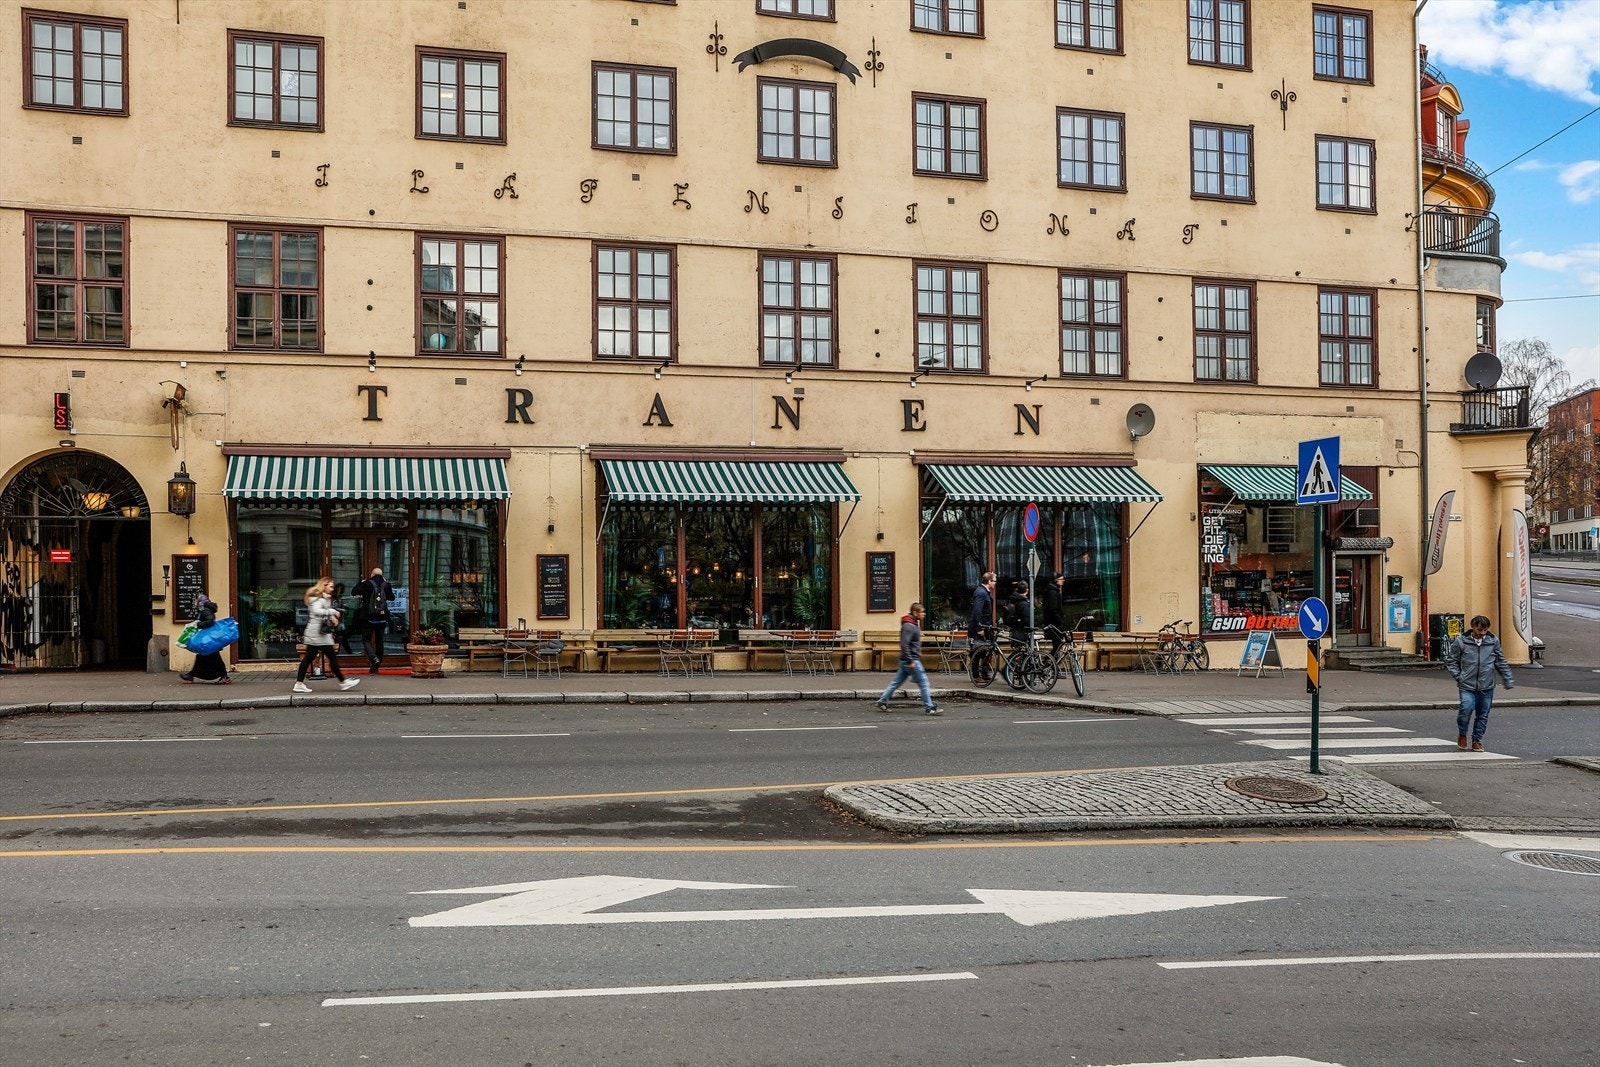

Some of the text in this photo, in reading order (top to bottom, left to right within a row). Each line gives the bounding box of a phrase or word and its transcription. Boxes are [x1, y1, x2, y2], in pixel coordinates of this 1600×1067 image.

[358, 384, 1044, 436] TRANEN
[1202, 517, 1226, 526] GET
[1203, 526, 1220, 535] FIT
[1205, 536, 1224, 545] DIE
[1202, 545, 1226, 554] TRY
[1204, 554, 1225, 563] ING
